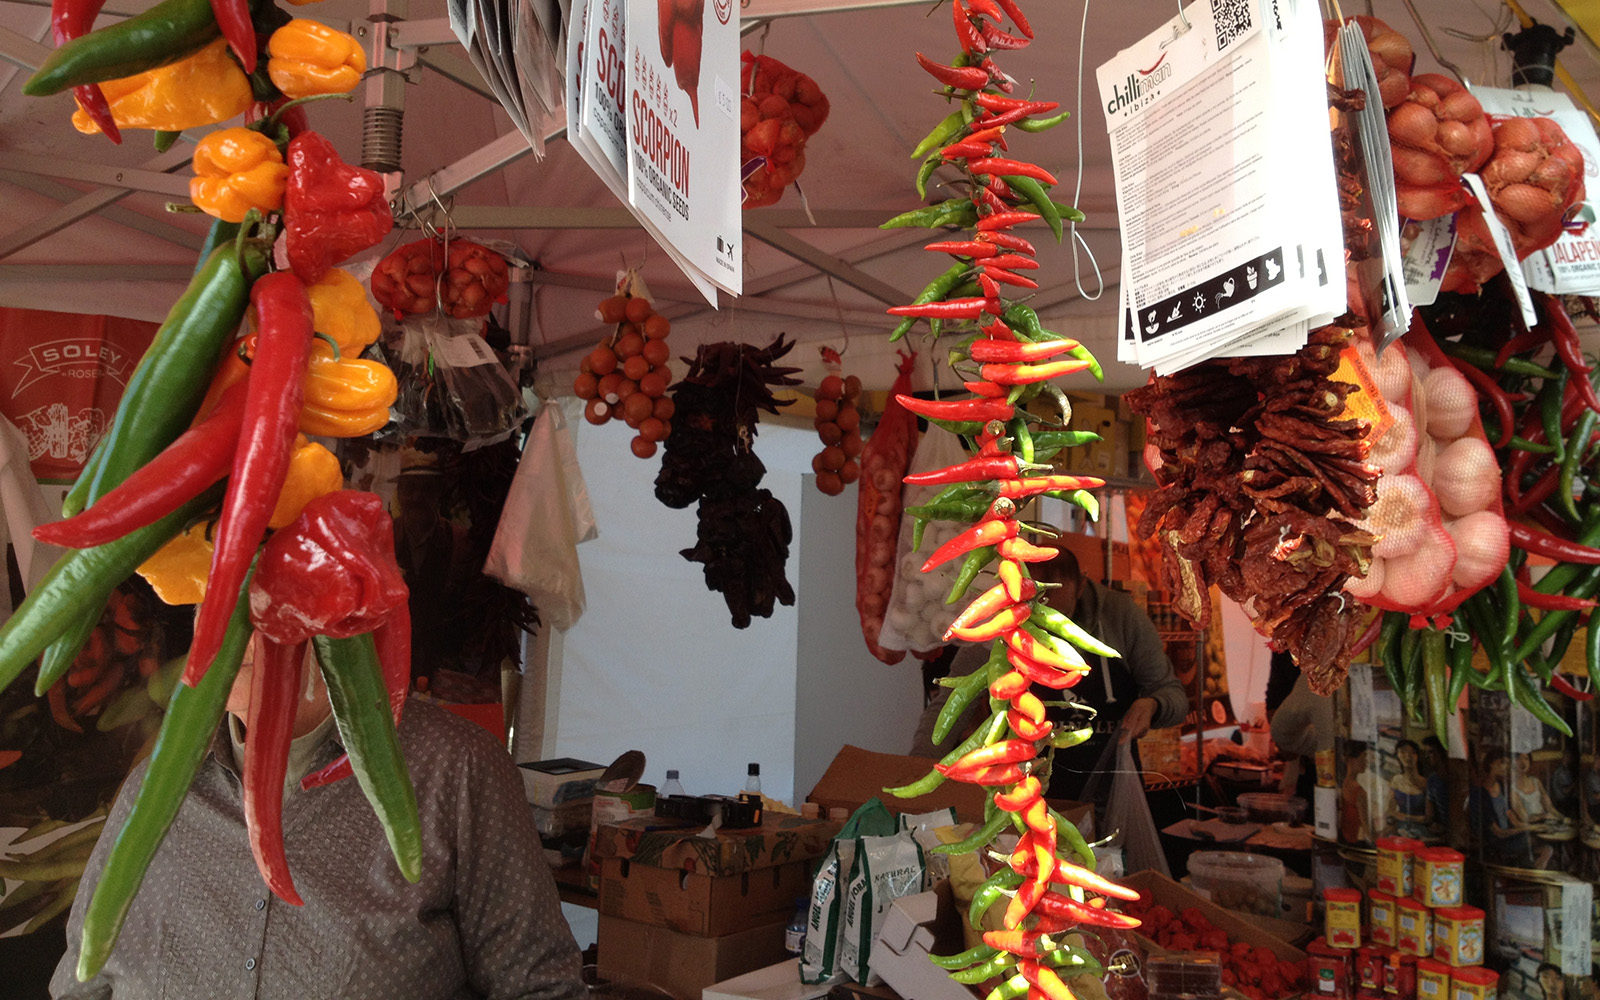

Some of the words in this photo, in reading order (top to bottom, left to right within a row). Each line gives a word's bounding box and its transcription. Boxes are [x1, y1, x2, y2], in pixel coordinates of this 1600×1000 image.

[1107, 63, 1172, 115] chilliman
[633, 89, 690, 199] SCORPION
[634, 149, 649, 179] 100%
[649, 165, 672, 204] ORGANIC
[672, 191, 690, 221] SEEDS
[42, 344, 122, 365] SOLEY
[874, 865, 917, 884] NATURAL
[810, 904, 821, 932] ANGEL
[846, 902, 856, 928] ANGEL
